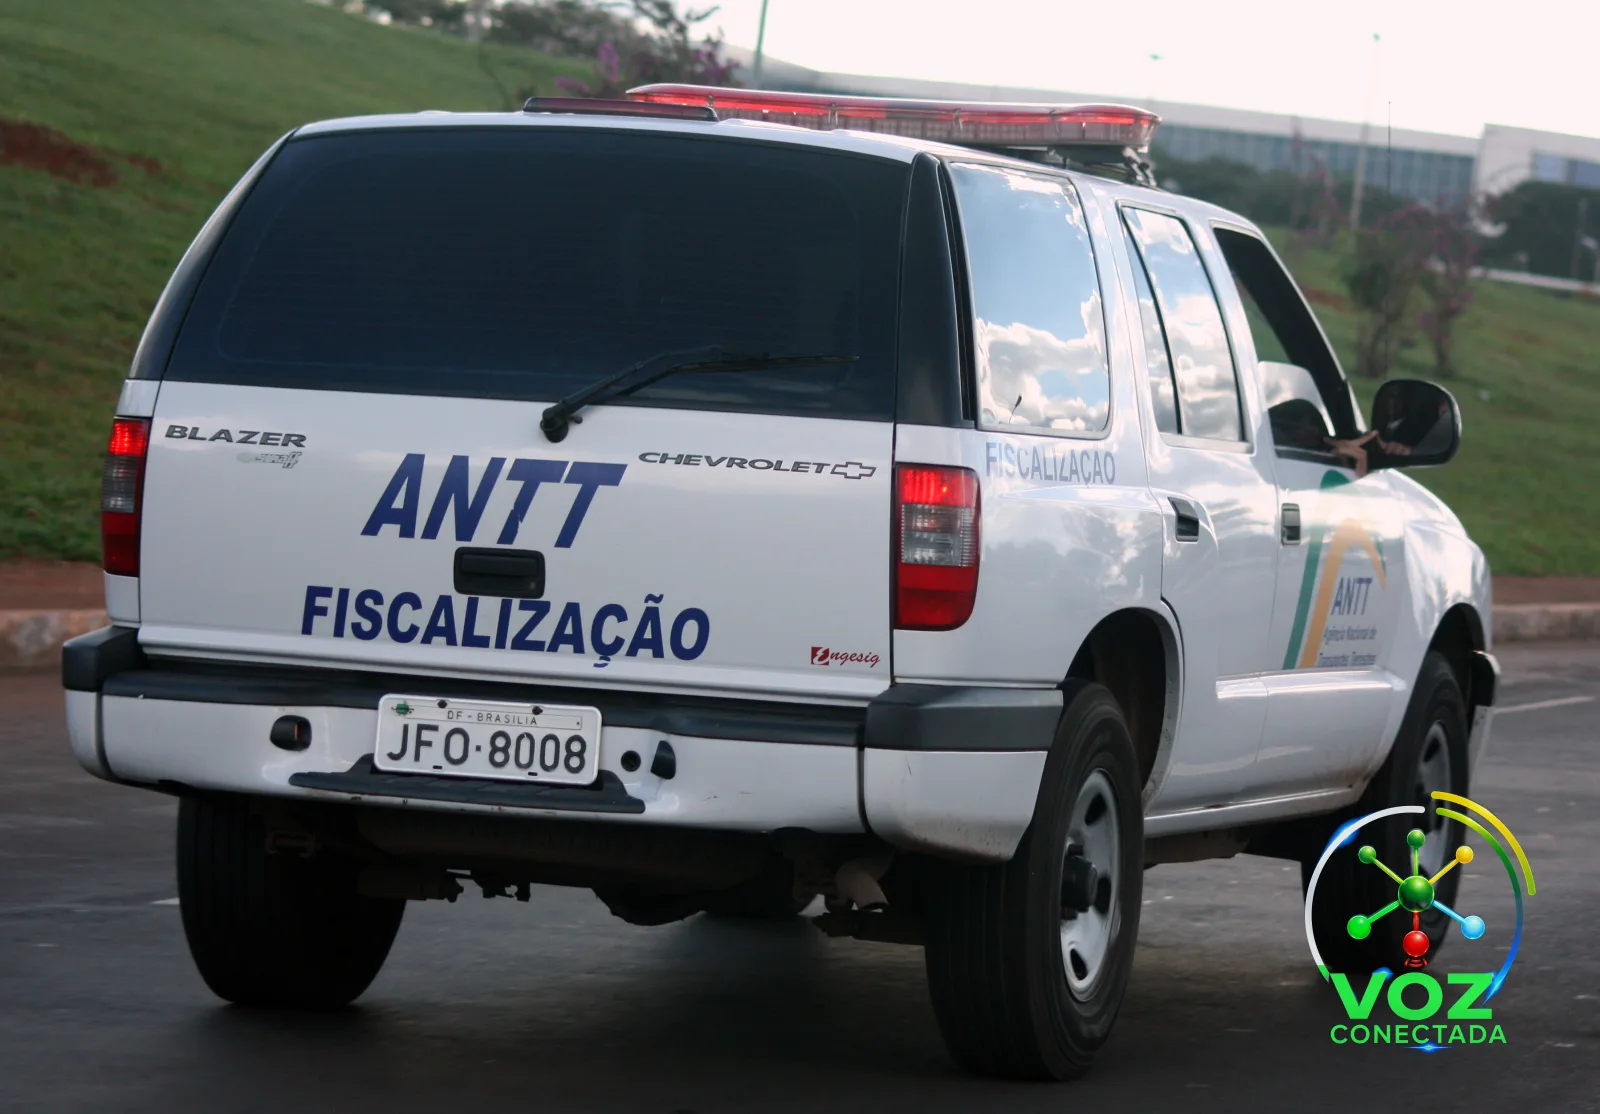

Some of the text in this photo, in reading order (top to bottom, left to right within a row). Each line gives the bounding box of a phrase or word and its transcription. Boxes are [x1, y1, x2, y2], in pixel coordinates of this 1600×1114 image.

[164, 424, 307, 448] BLAZER
[638, 451, 831, 475] CHEVROLET
[361, 453, 628, 549] ANTT
[1330, 576, 1373, 616] ANTT
[301, 585, 710, 668] FISCALIZAÇÃO
[447, 710, 462, 720] DF
